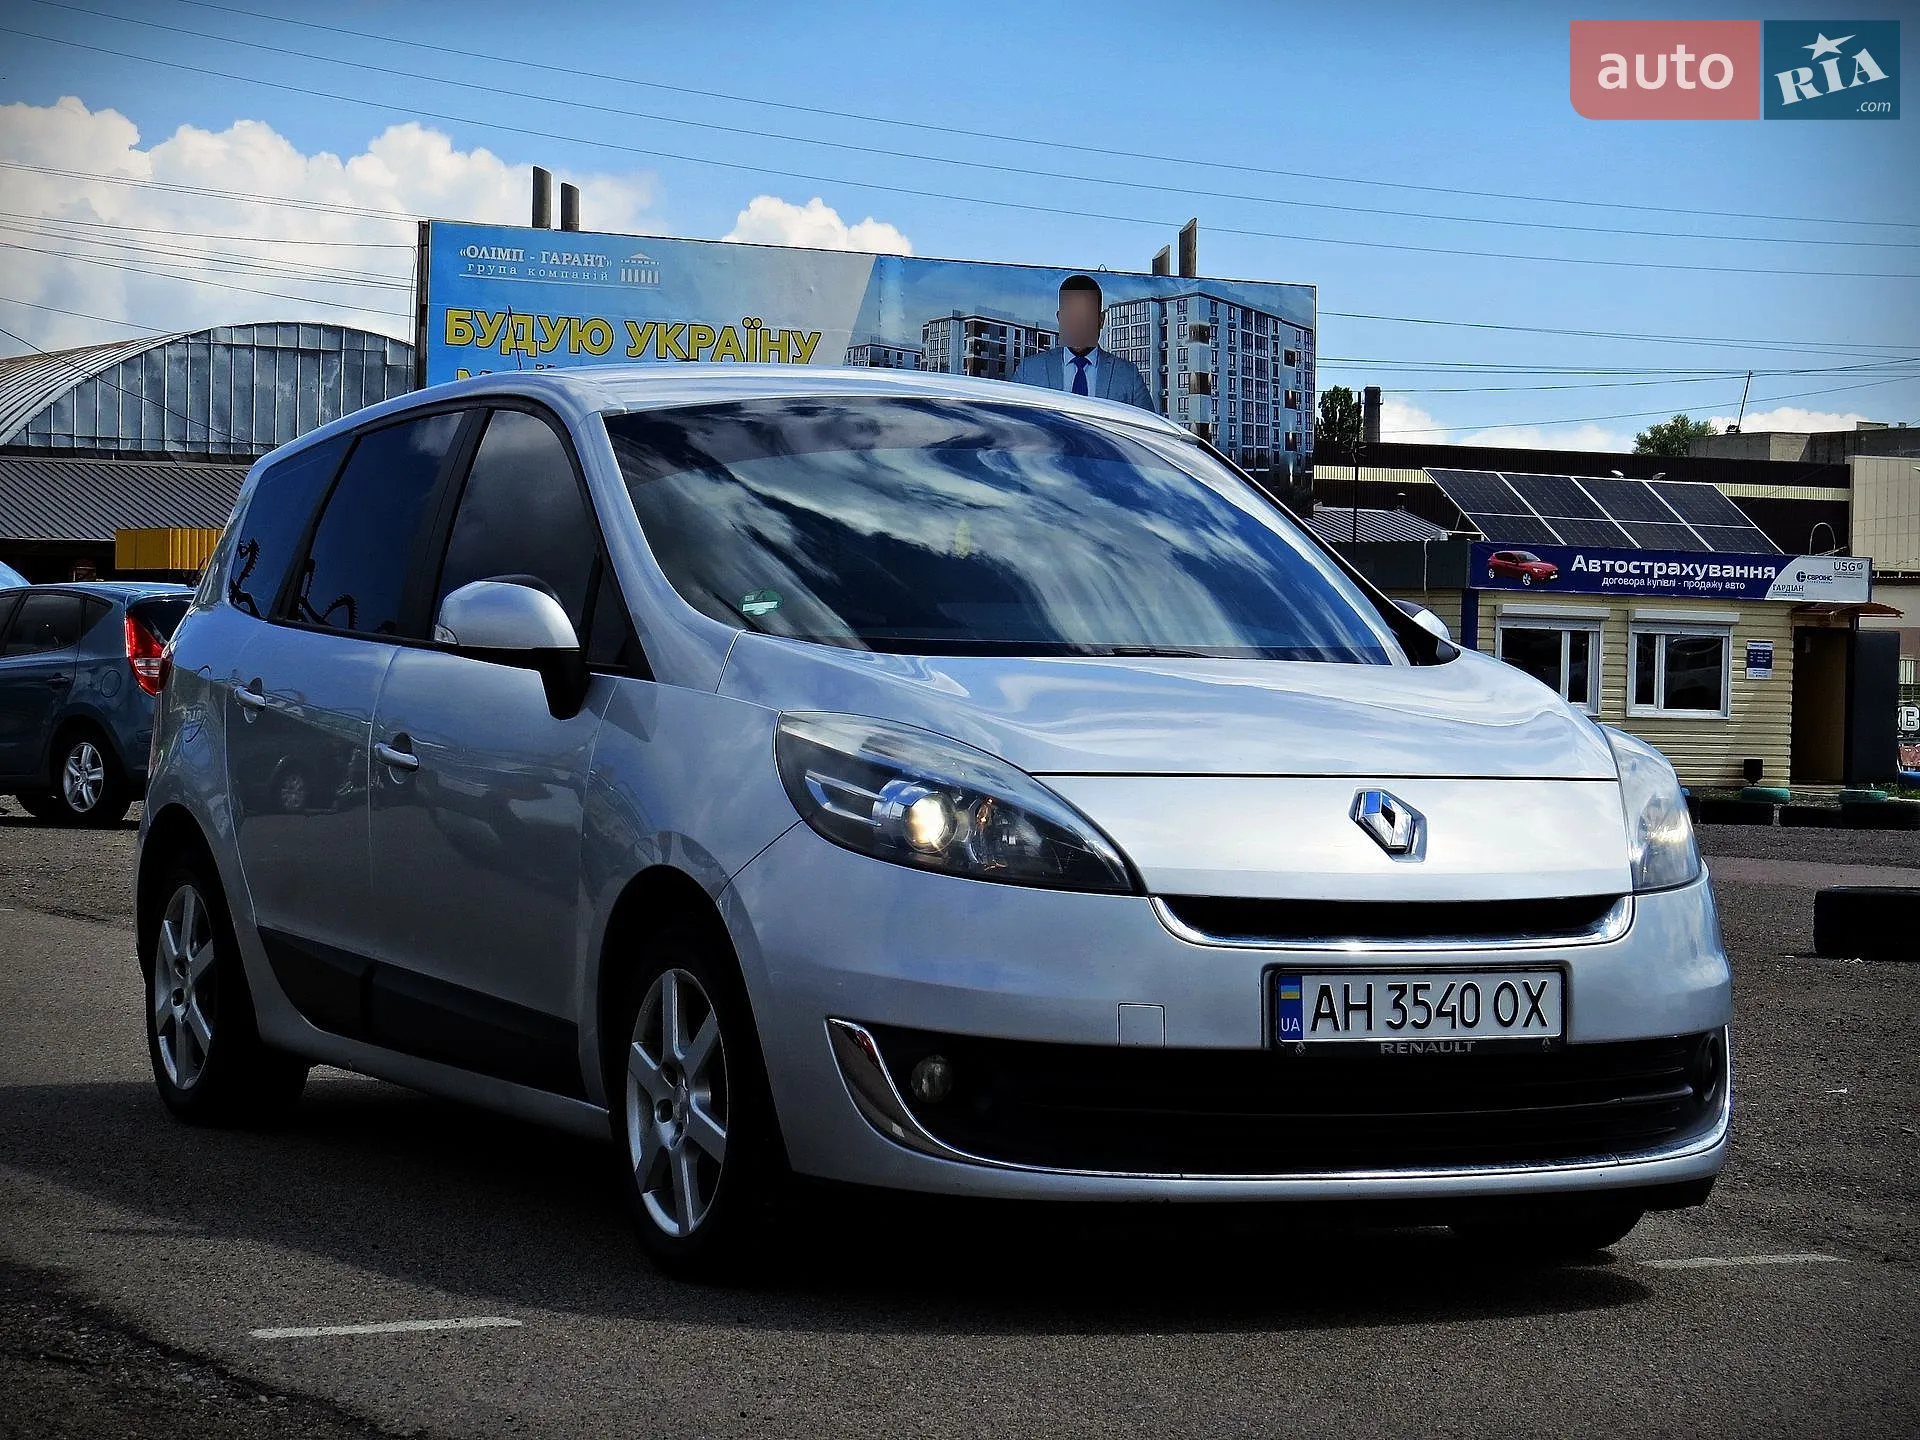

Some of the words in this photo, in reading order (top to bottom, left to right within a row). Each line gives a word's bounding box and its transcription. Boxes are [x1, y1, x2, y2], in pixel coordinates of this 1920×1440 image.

[467, 263, 518, 278] група
[528, 268, 608, 281] компаній
[444, 308, 614, 357] БУДУЮ
[625, 316, 822, 364] УКРАЇНУ
[1571, 555, 1776, 580] Автострахування
[1833, 561, 1856, 571] USG
[1602, 577, 1645, 587] договора
[1647, 578, 1676, 588] купівлі
[1683, 580, 1723, 590] продажу
[1725, 582, 1746, 590] авто
[1311, 982, 1374, 1031] AH
[1386, 980, 1482, 1030] 3540
[1494, 979, 1548, 1028] OX
[1281, 1017, 1300, 1032] UA
[1380, 1041, 1476, 1055] RENAULT
